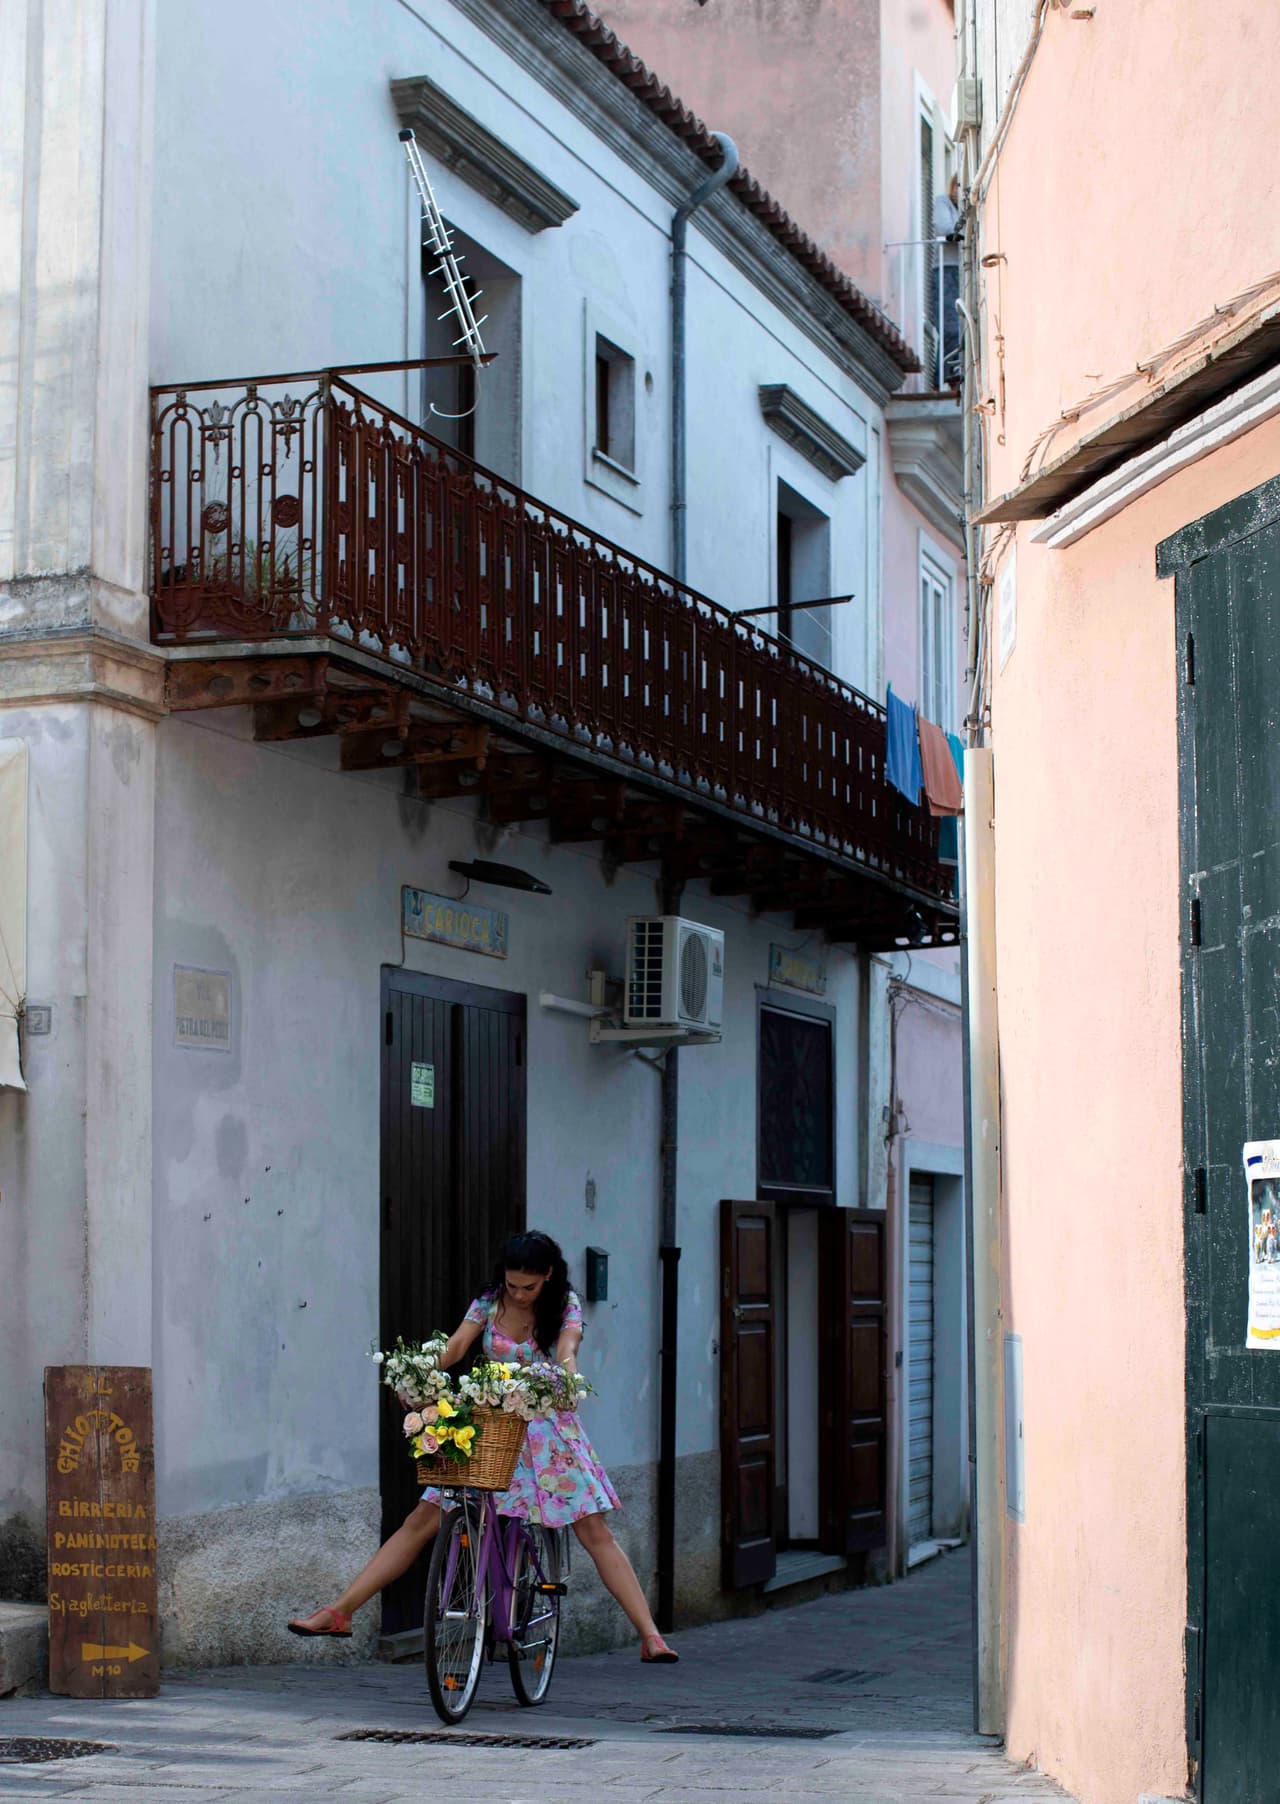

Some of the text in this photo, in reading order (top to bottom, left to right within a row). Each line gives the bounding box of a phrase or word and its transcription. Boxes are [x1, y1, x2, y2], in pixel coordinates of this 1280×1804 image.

[424, 903, 490, 942] CARIOCA
[32, 1012, 43, 1031] 2
[85, 1375, 113, 1395] IL
[57, 1410, 140, 1473] GHIOTTONE
[59, 1496, 146, 1518] BIRRERIA
[55, 1530, 157, 1550] PANINOTECA
[52, 1561, 152, 1578] ROSTICCERIA
